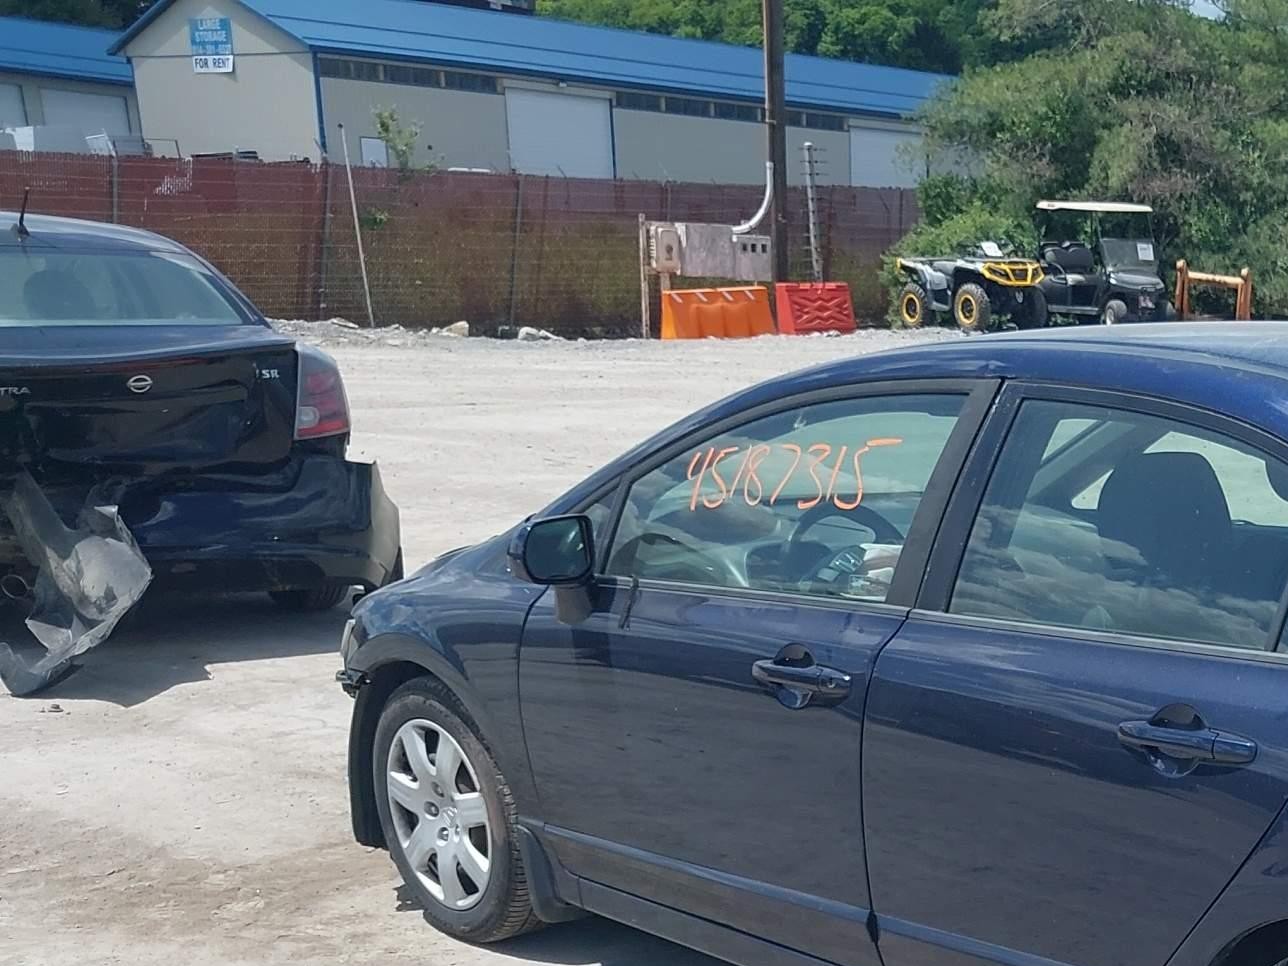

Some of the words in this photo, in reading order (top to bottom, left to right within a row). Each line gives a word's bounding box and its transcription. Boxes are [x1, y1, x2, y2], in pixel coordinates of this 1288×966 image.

[195, 30, 227, 42] STORAGE
[194, 57, 209, 69] FOR
[212, 57, 230, 69] RENT
[687, 438, 903, 511] 45187315
